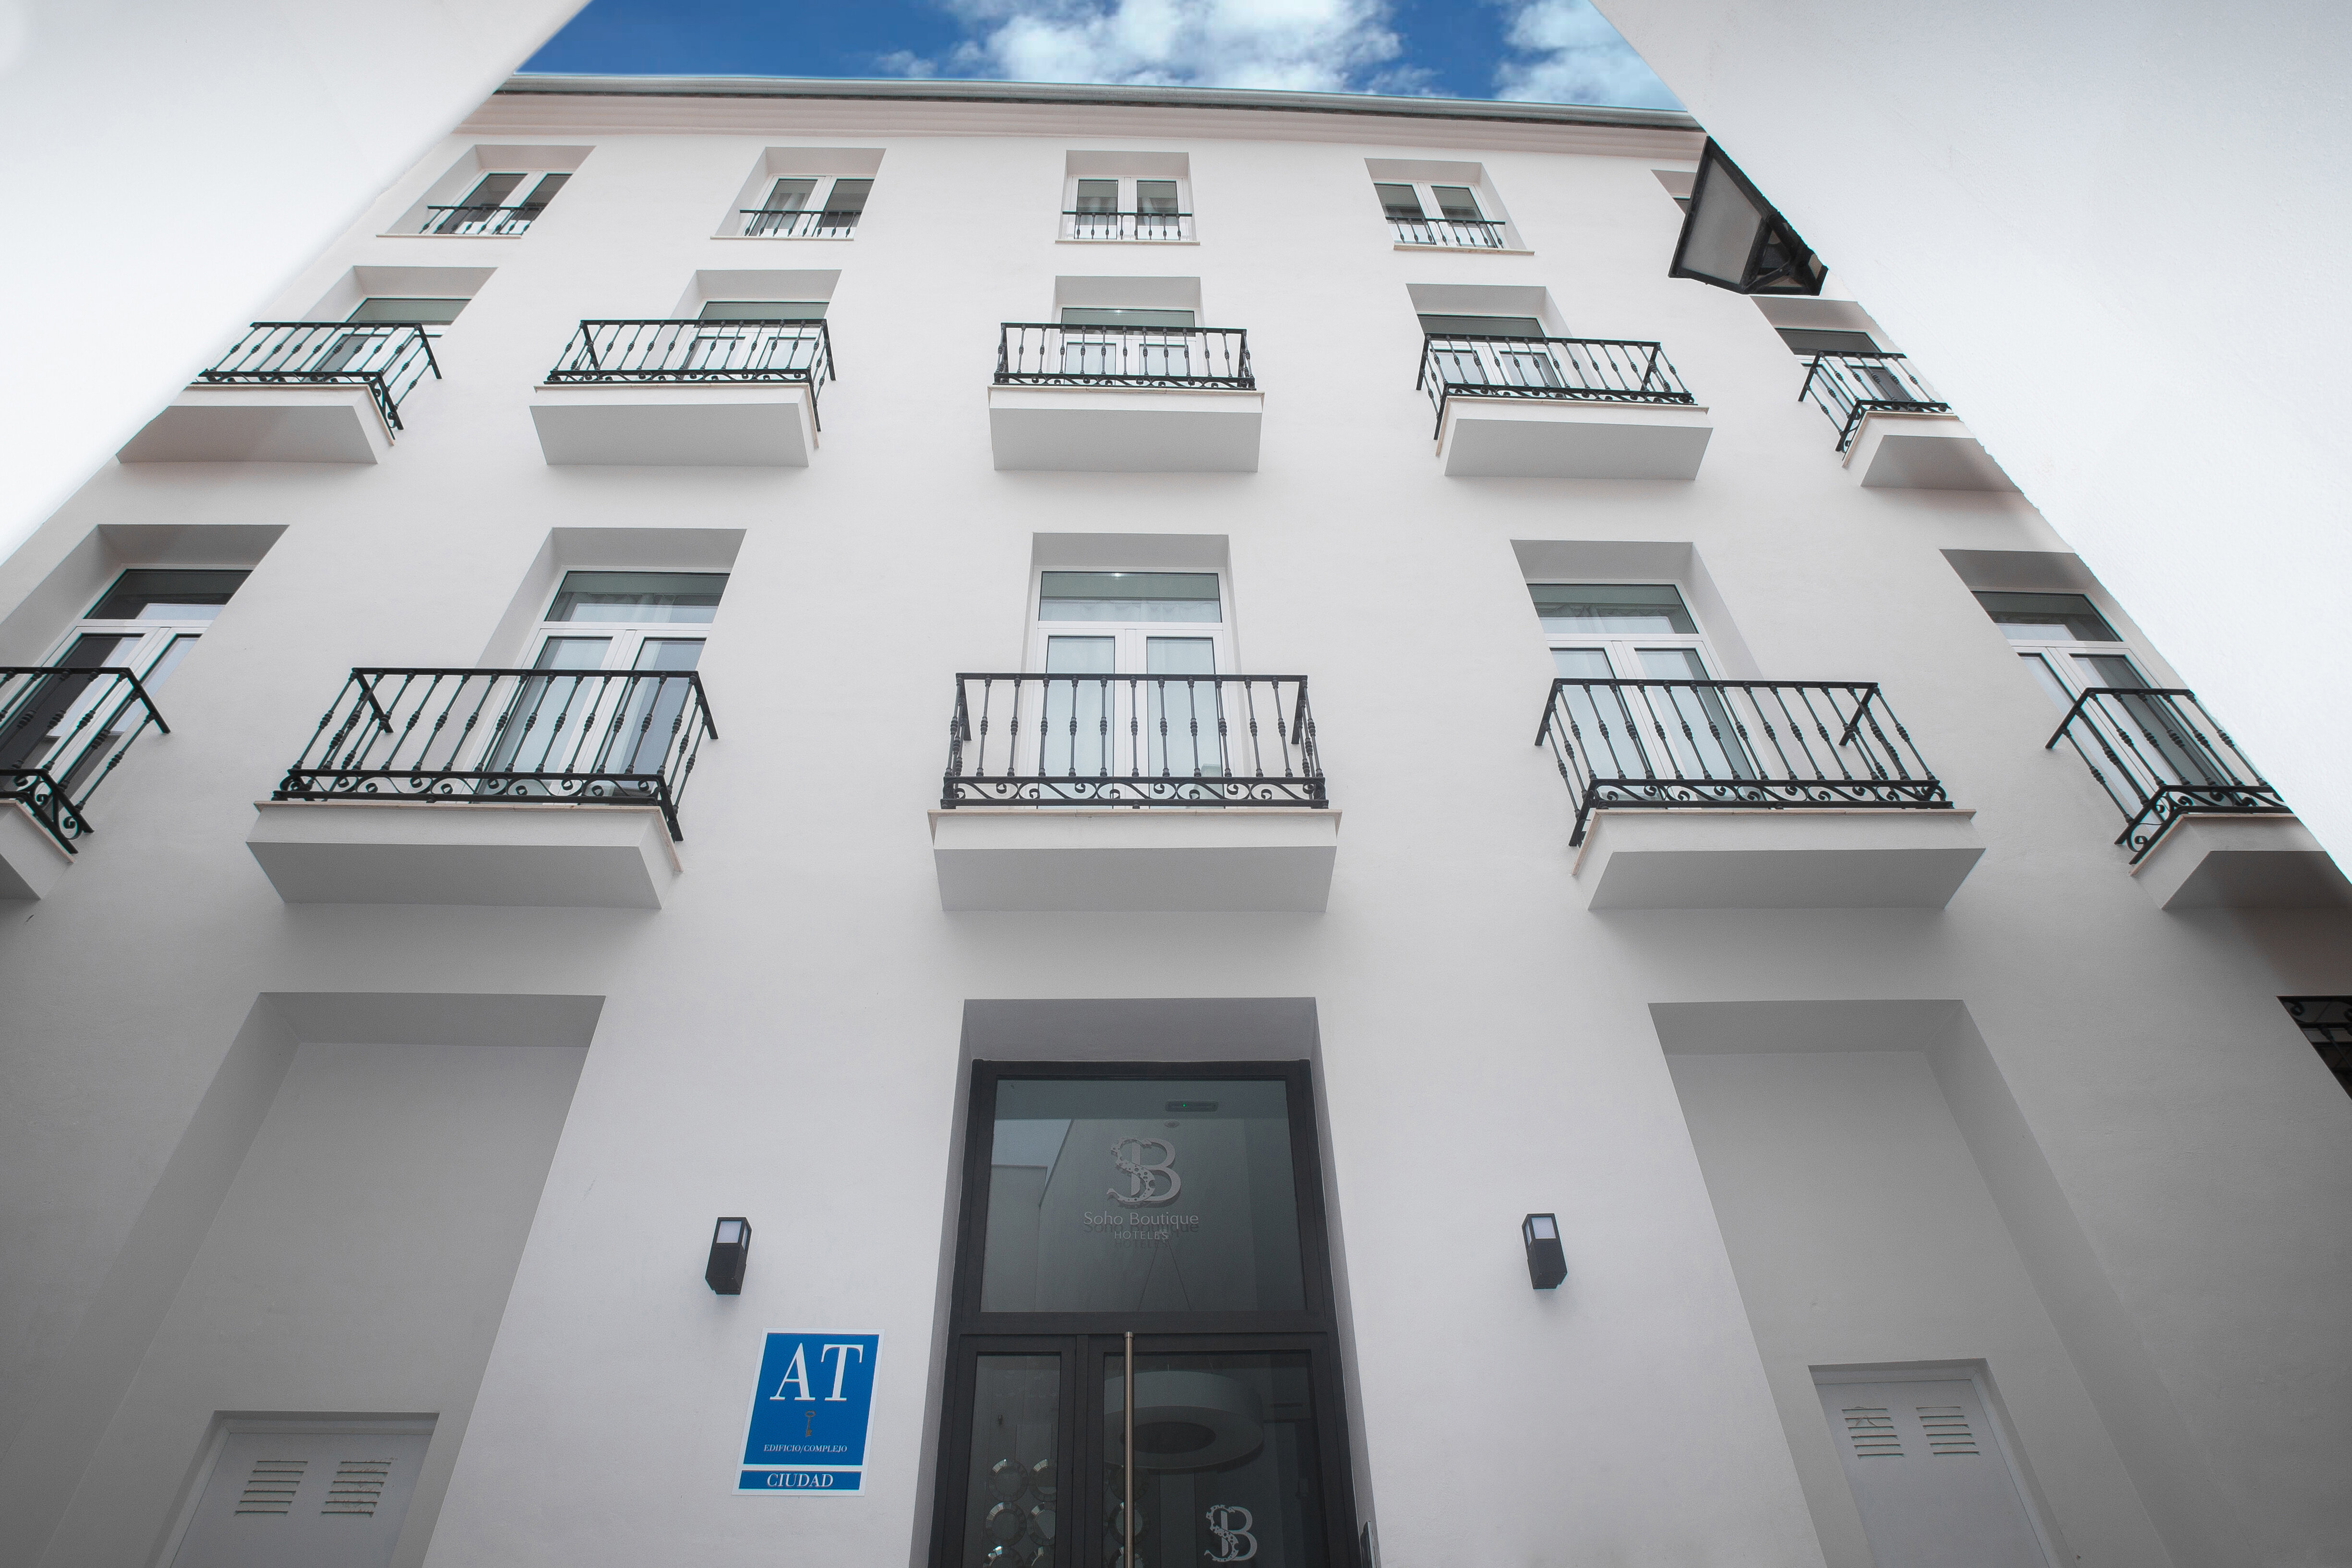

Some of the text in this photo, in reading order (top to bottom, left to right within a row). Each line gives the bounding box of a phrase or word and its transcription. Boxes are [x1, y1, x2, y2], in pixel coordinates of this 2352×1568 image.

[1083, 1211, 1199, 1230] Soho Boutique
[1114, 1231, 1168, 1240] HOTELES
[769, 1342, 864, 1401] AT
[764, 1444, 847, 1453] EDIFICIO/COMPLEJO
[767, 1473, 834, 1487] CIUDAD
